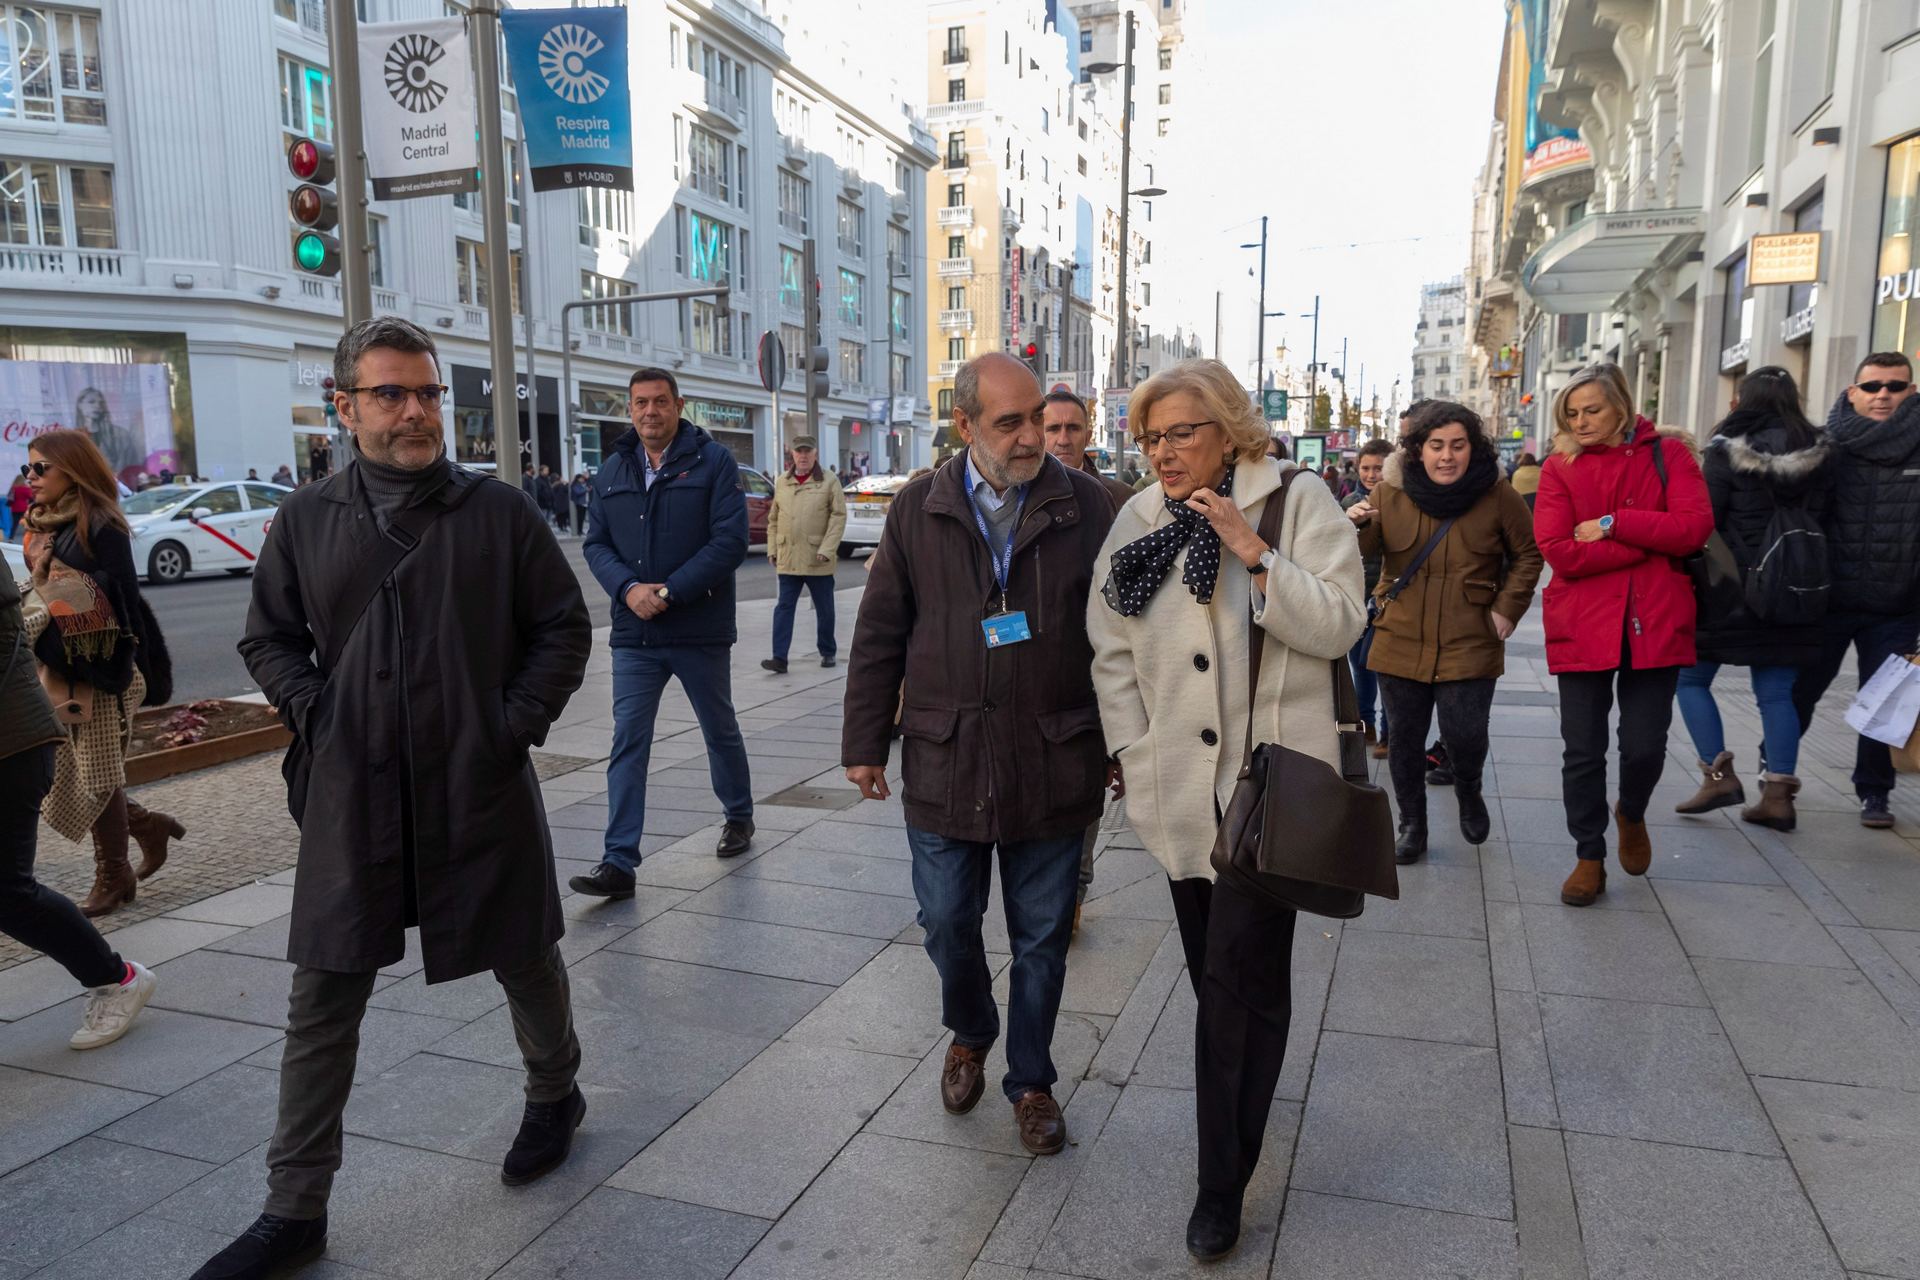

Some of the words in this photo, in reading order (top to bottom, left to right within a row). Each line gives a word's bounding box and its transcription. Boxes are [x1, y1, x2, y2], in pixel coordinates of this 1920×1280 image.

[401, 122, 447, 141] Madrid
[556, 116, 611, 132] Respira
[561, 134, 611, 149] Madrid
[402, 141, 449, 160] Central
[578, 171, 614, 183] MADRID
[390, 178, 463, 193] madrid.es/madridcentral
[1606, 219, 1642, 231] HYATT
[1646, 216, 1698, 229] CENTRIC
[1003, 543, 1013, 569] MADRID
